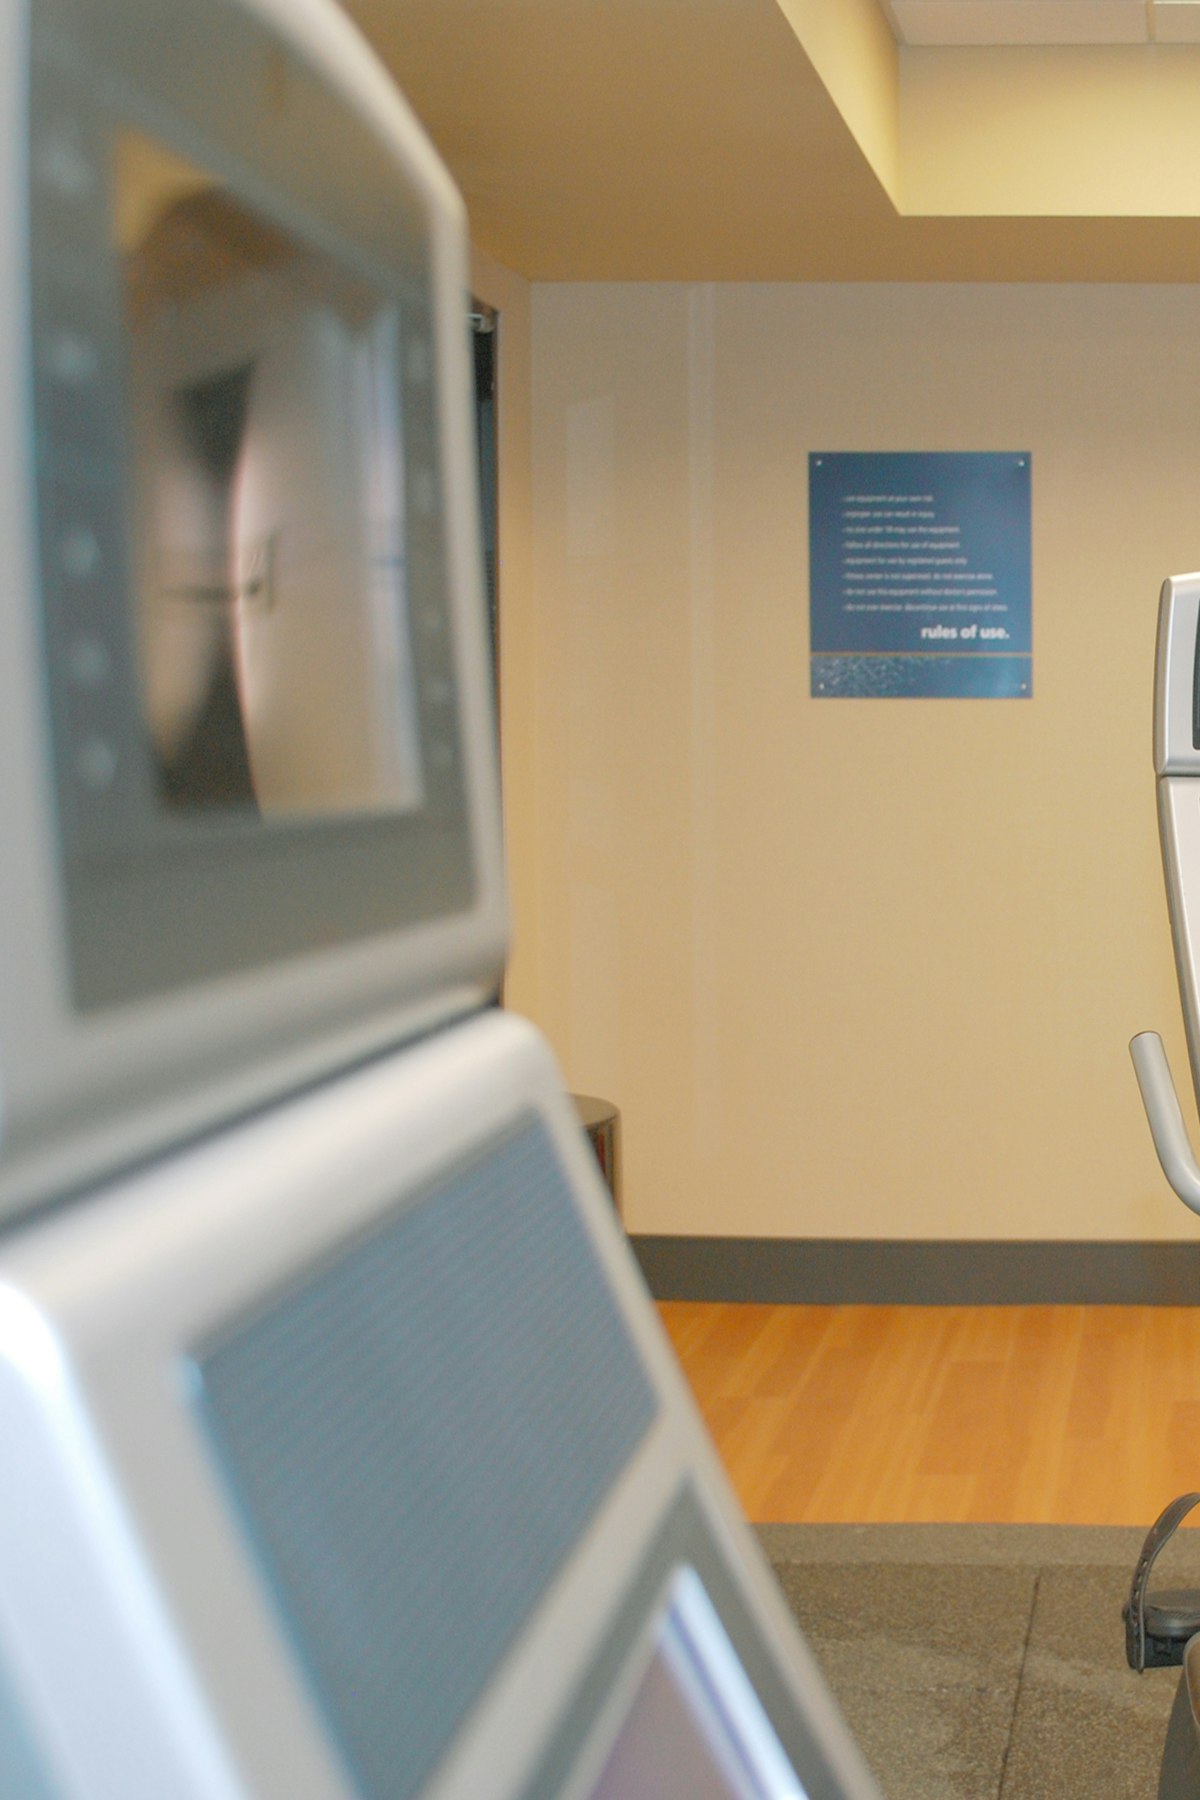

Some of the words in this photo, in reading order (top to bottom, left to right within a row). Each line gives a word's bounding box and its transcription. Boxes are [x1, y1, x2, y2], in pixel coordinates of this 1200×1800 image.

[921, 624, 958, 639] rules
[960, 624, 978, 639] of
[979, 627, 1010, 639] use.
